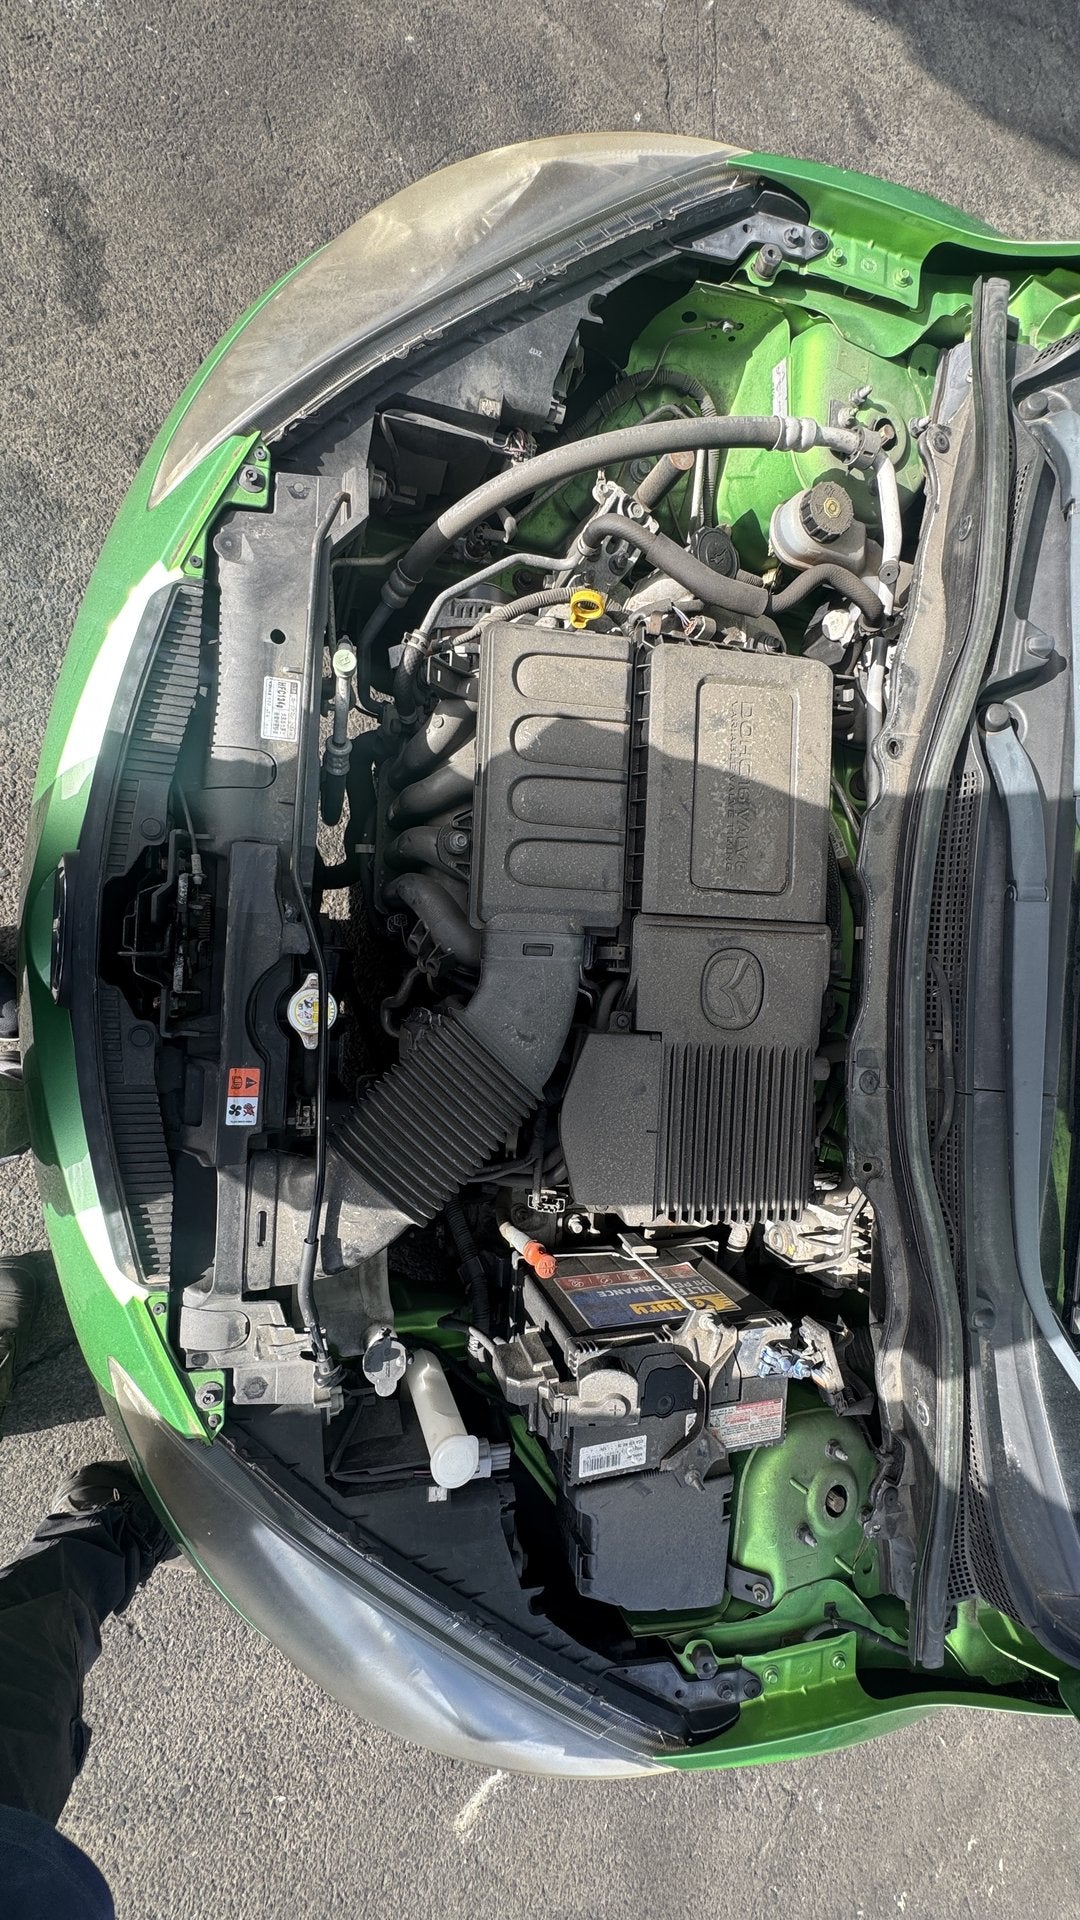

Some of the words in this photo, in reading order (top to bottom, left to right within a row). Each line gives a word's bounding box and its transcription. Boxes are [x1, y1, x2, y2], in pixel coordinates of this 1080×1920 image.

[738, 701, 753, 776] DOHC
[728, 775, 737, 818] VALVE
[735, 808, 750, 873] VALVE
